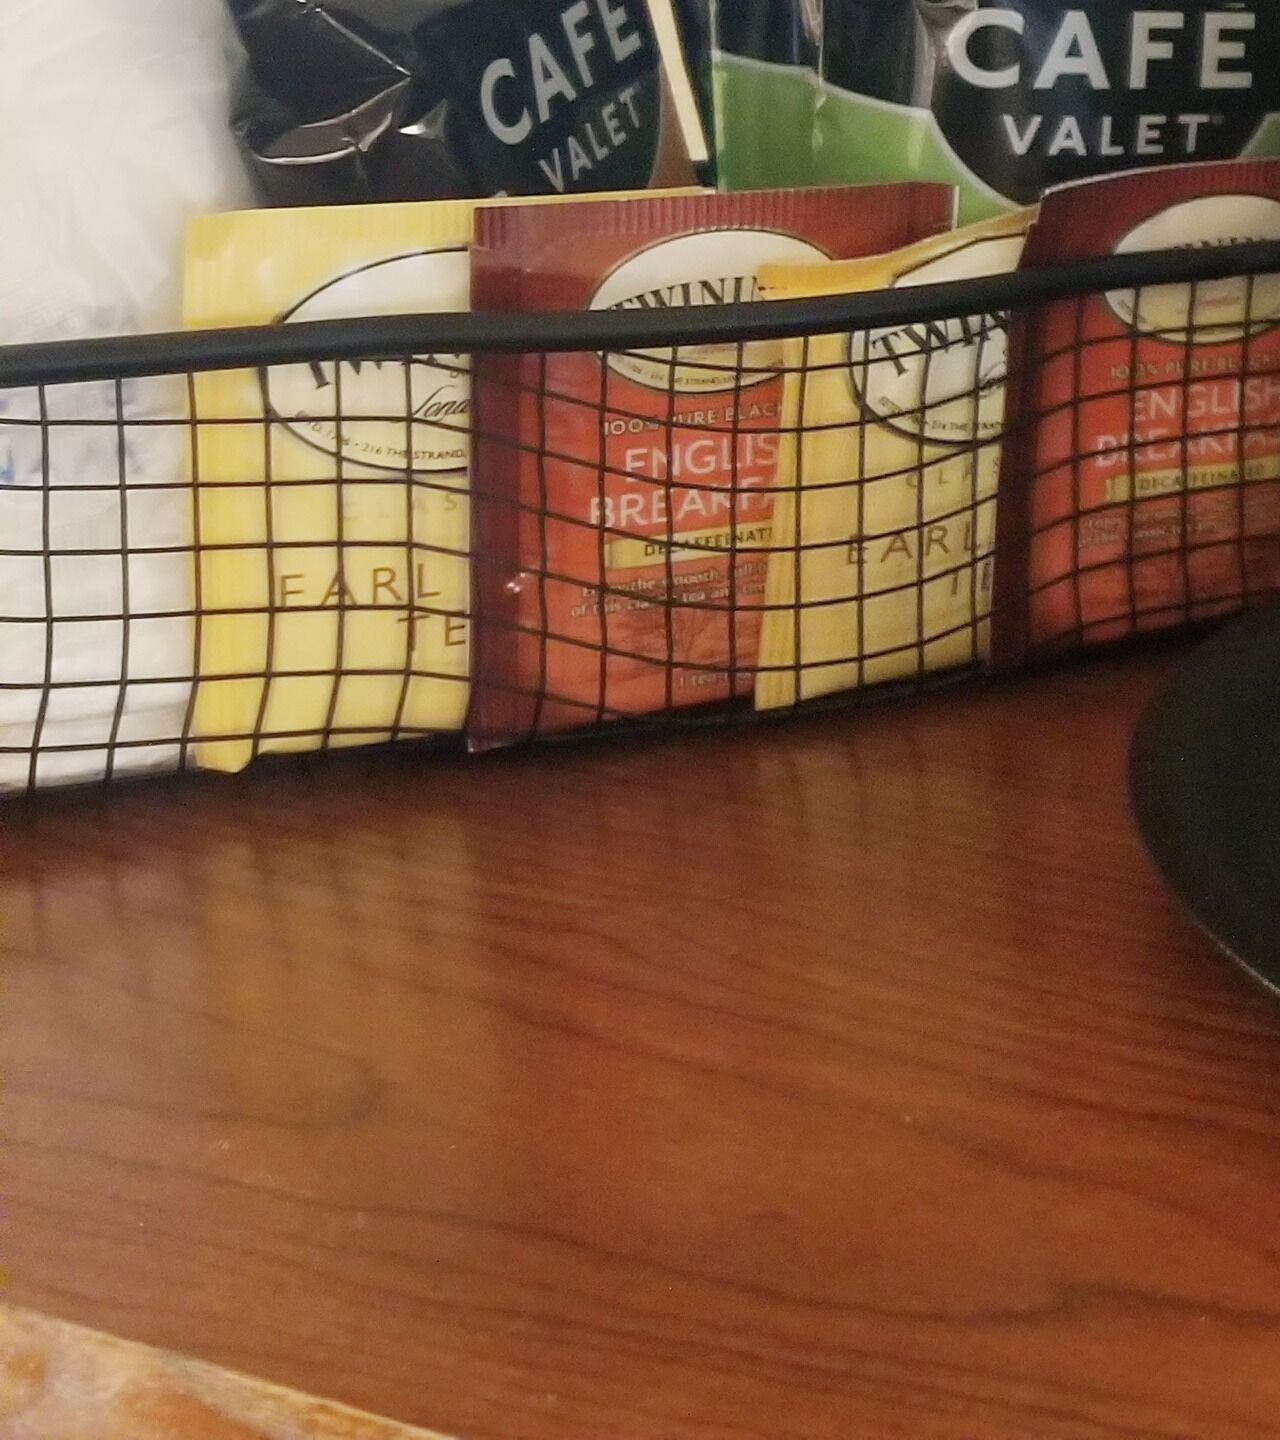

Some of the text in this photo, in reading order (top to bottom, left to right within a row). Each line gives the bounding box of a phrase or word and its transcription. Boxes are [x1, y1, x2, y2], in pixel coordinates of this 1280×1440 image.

[538, 82, 642, 193] VALET
[1002, 113, 1212, 157] VALET
[847, 520, 976, 565] EARL
